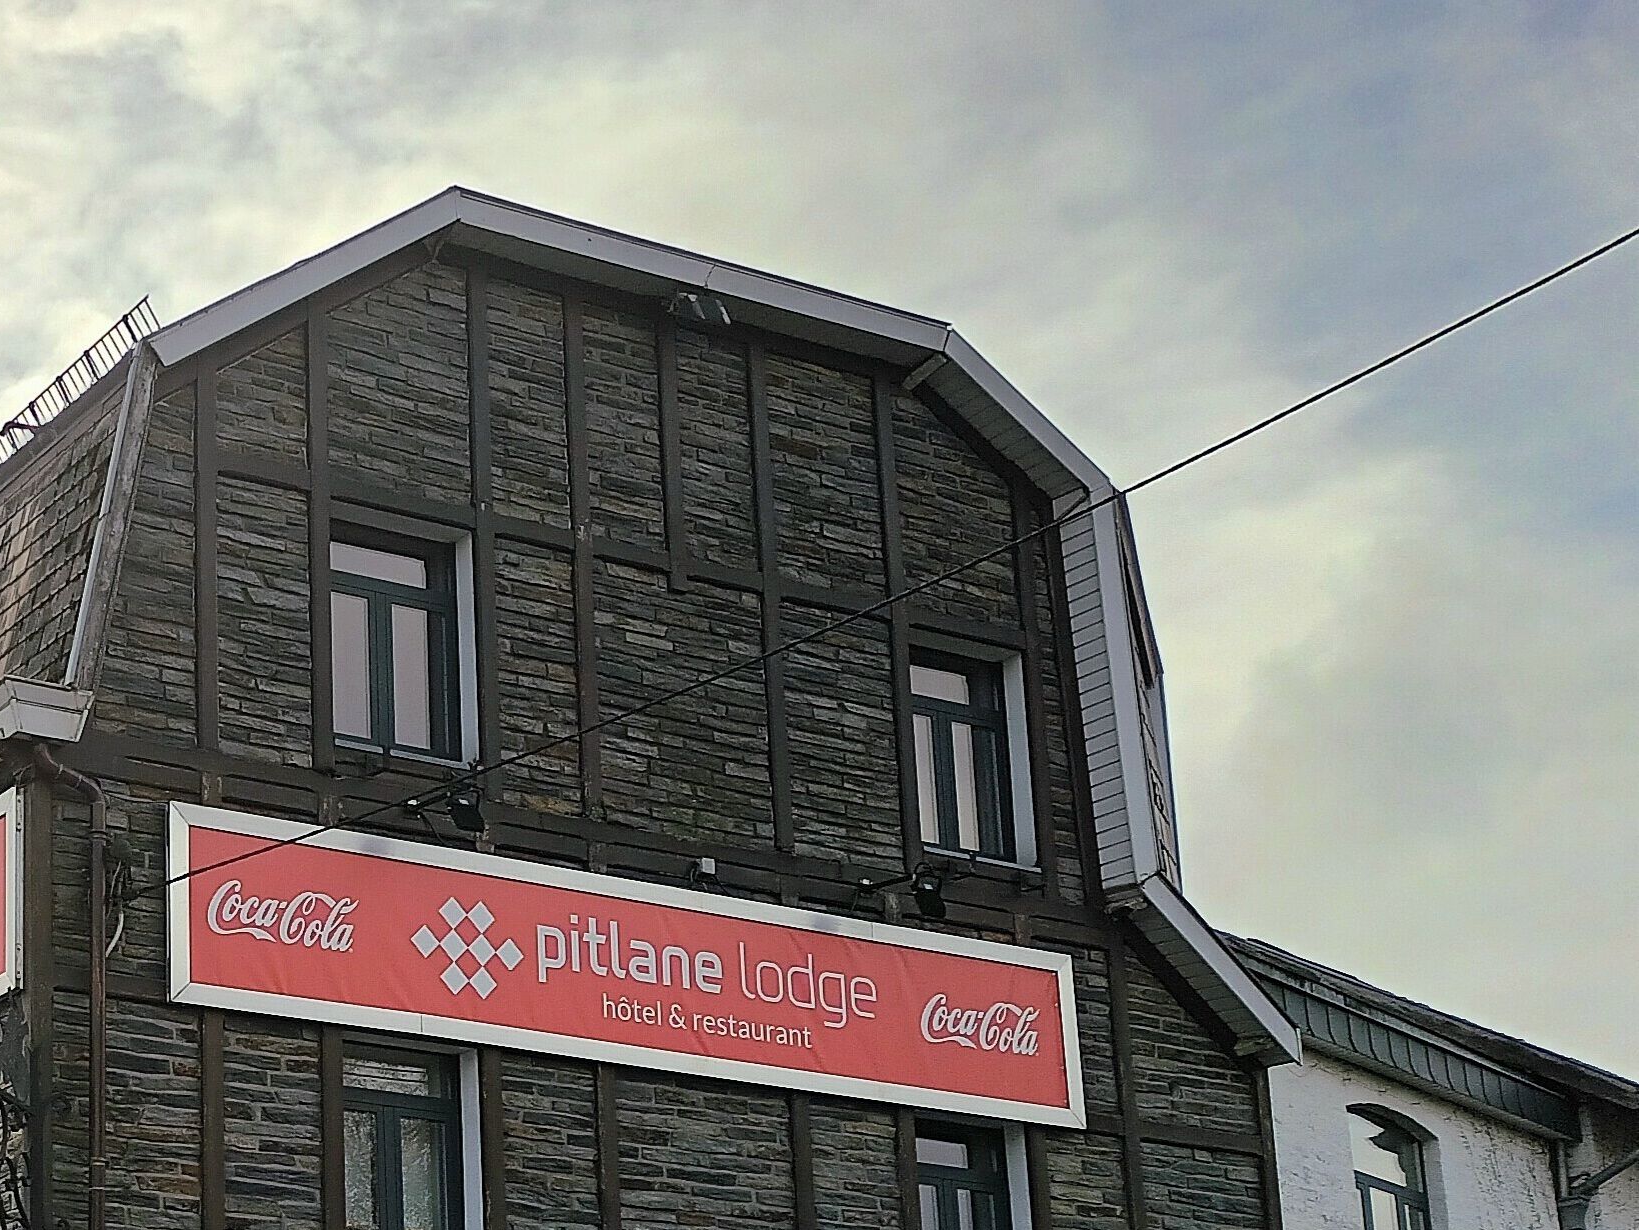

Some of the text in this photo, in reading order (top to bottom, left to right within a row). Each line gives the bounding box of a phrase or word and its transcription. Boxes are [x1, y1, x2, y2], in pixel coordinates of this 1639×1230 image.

[207, 879, 360, 953] Coca-Cola
[536, 914, 877, 1029] pitlane lodge
[603, 993, 813, 1049] hôtel & restaurant
[920, 993, 1041, 1057] Coca-Cola
